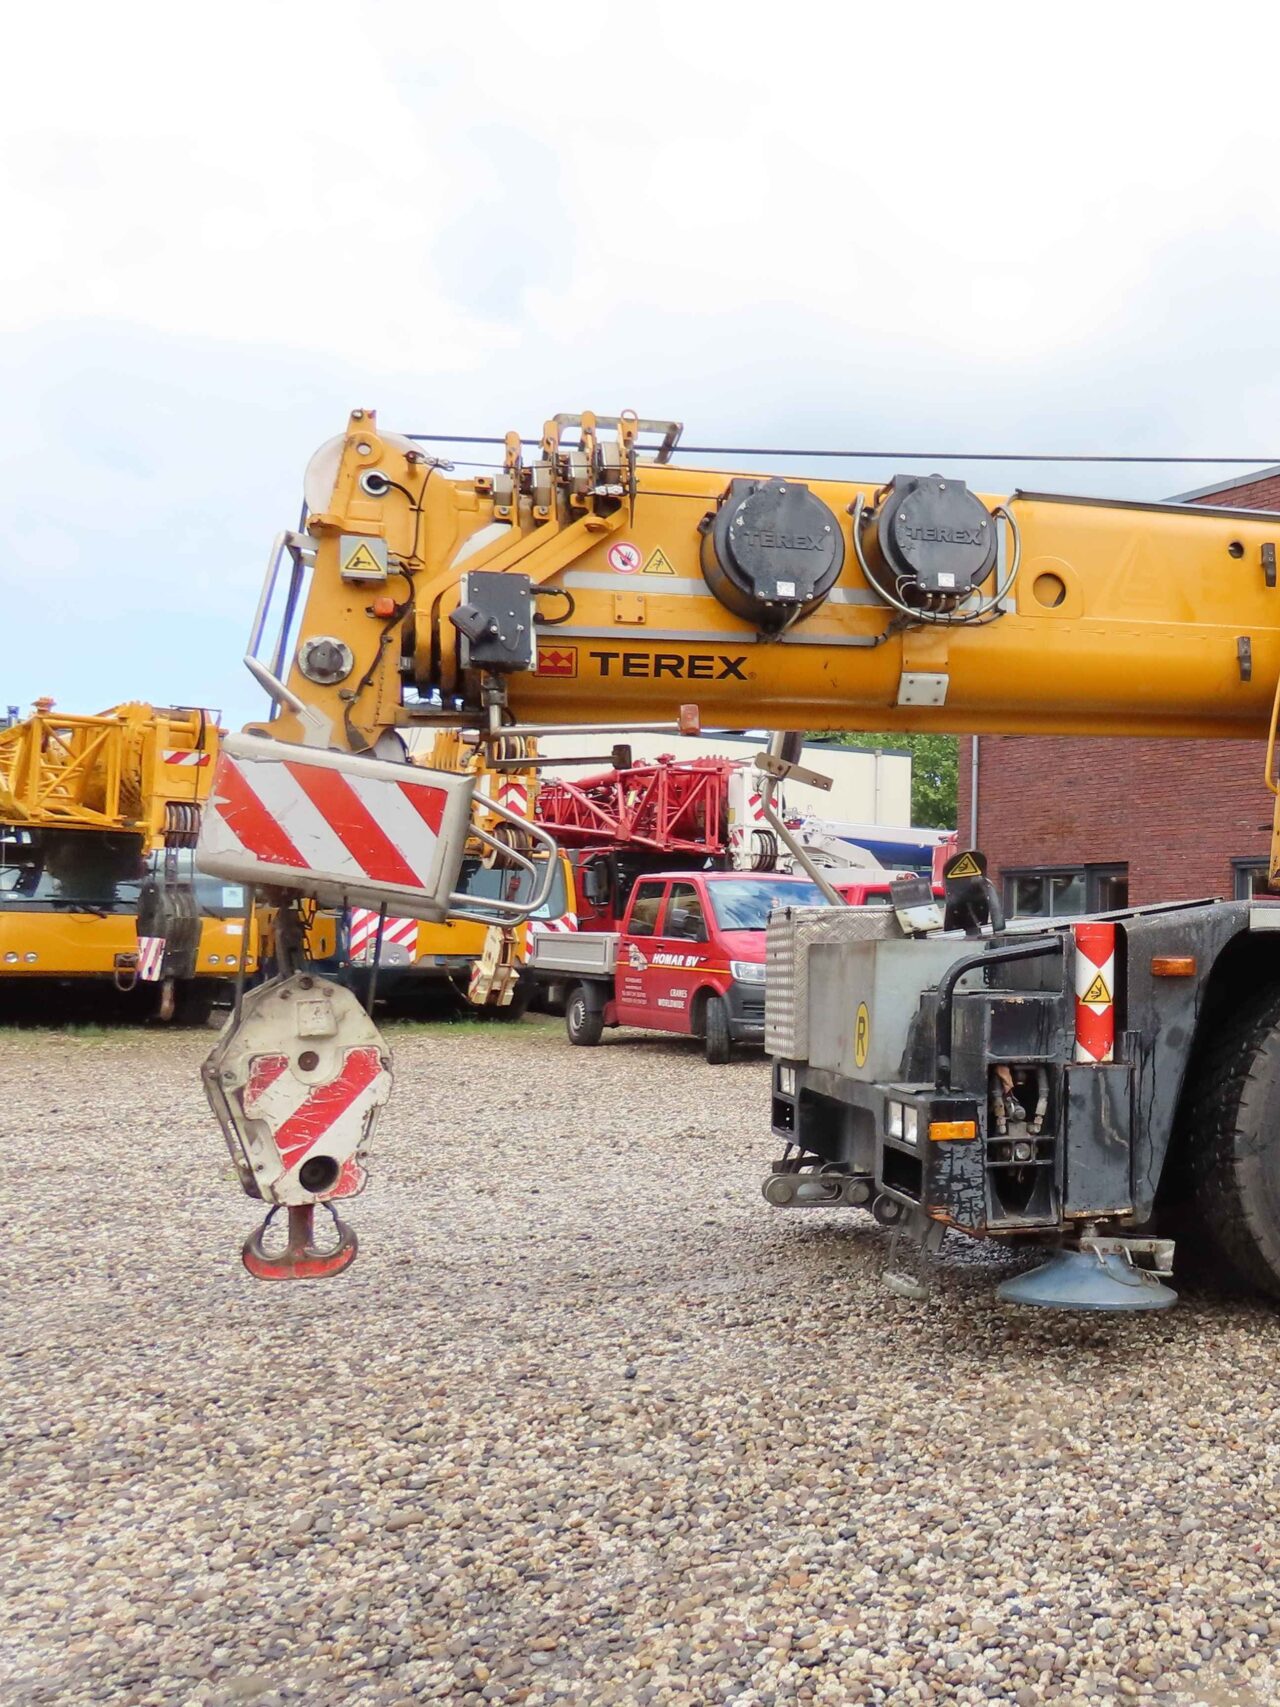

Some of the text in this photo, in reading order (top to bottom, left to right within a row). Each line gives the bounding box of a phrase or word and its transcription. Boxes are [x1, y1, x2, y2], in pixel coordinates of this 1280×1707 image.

[744, 530, 824, 551] TEREX
[905, 526, 982, 545] TEREX
[589, 651, 749, 681] TEREX
[651, 953, 700, 967] HOMAR BV
[856, 1015, 866, 1057] R
